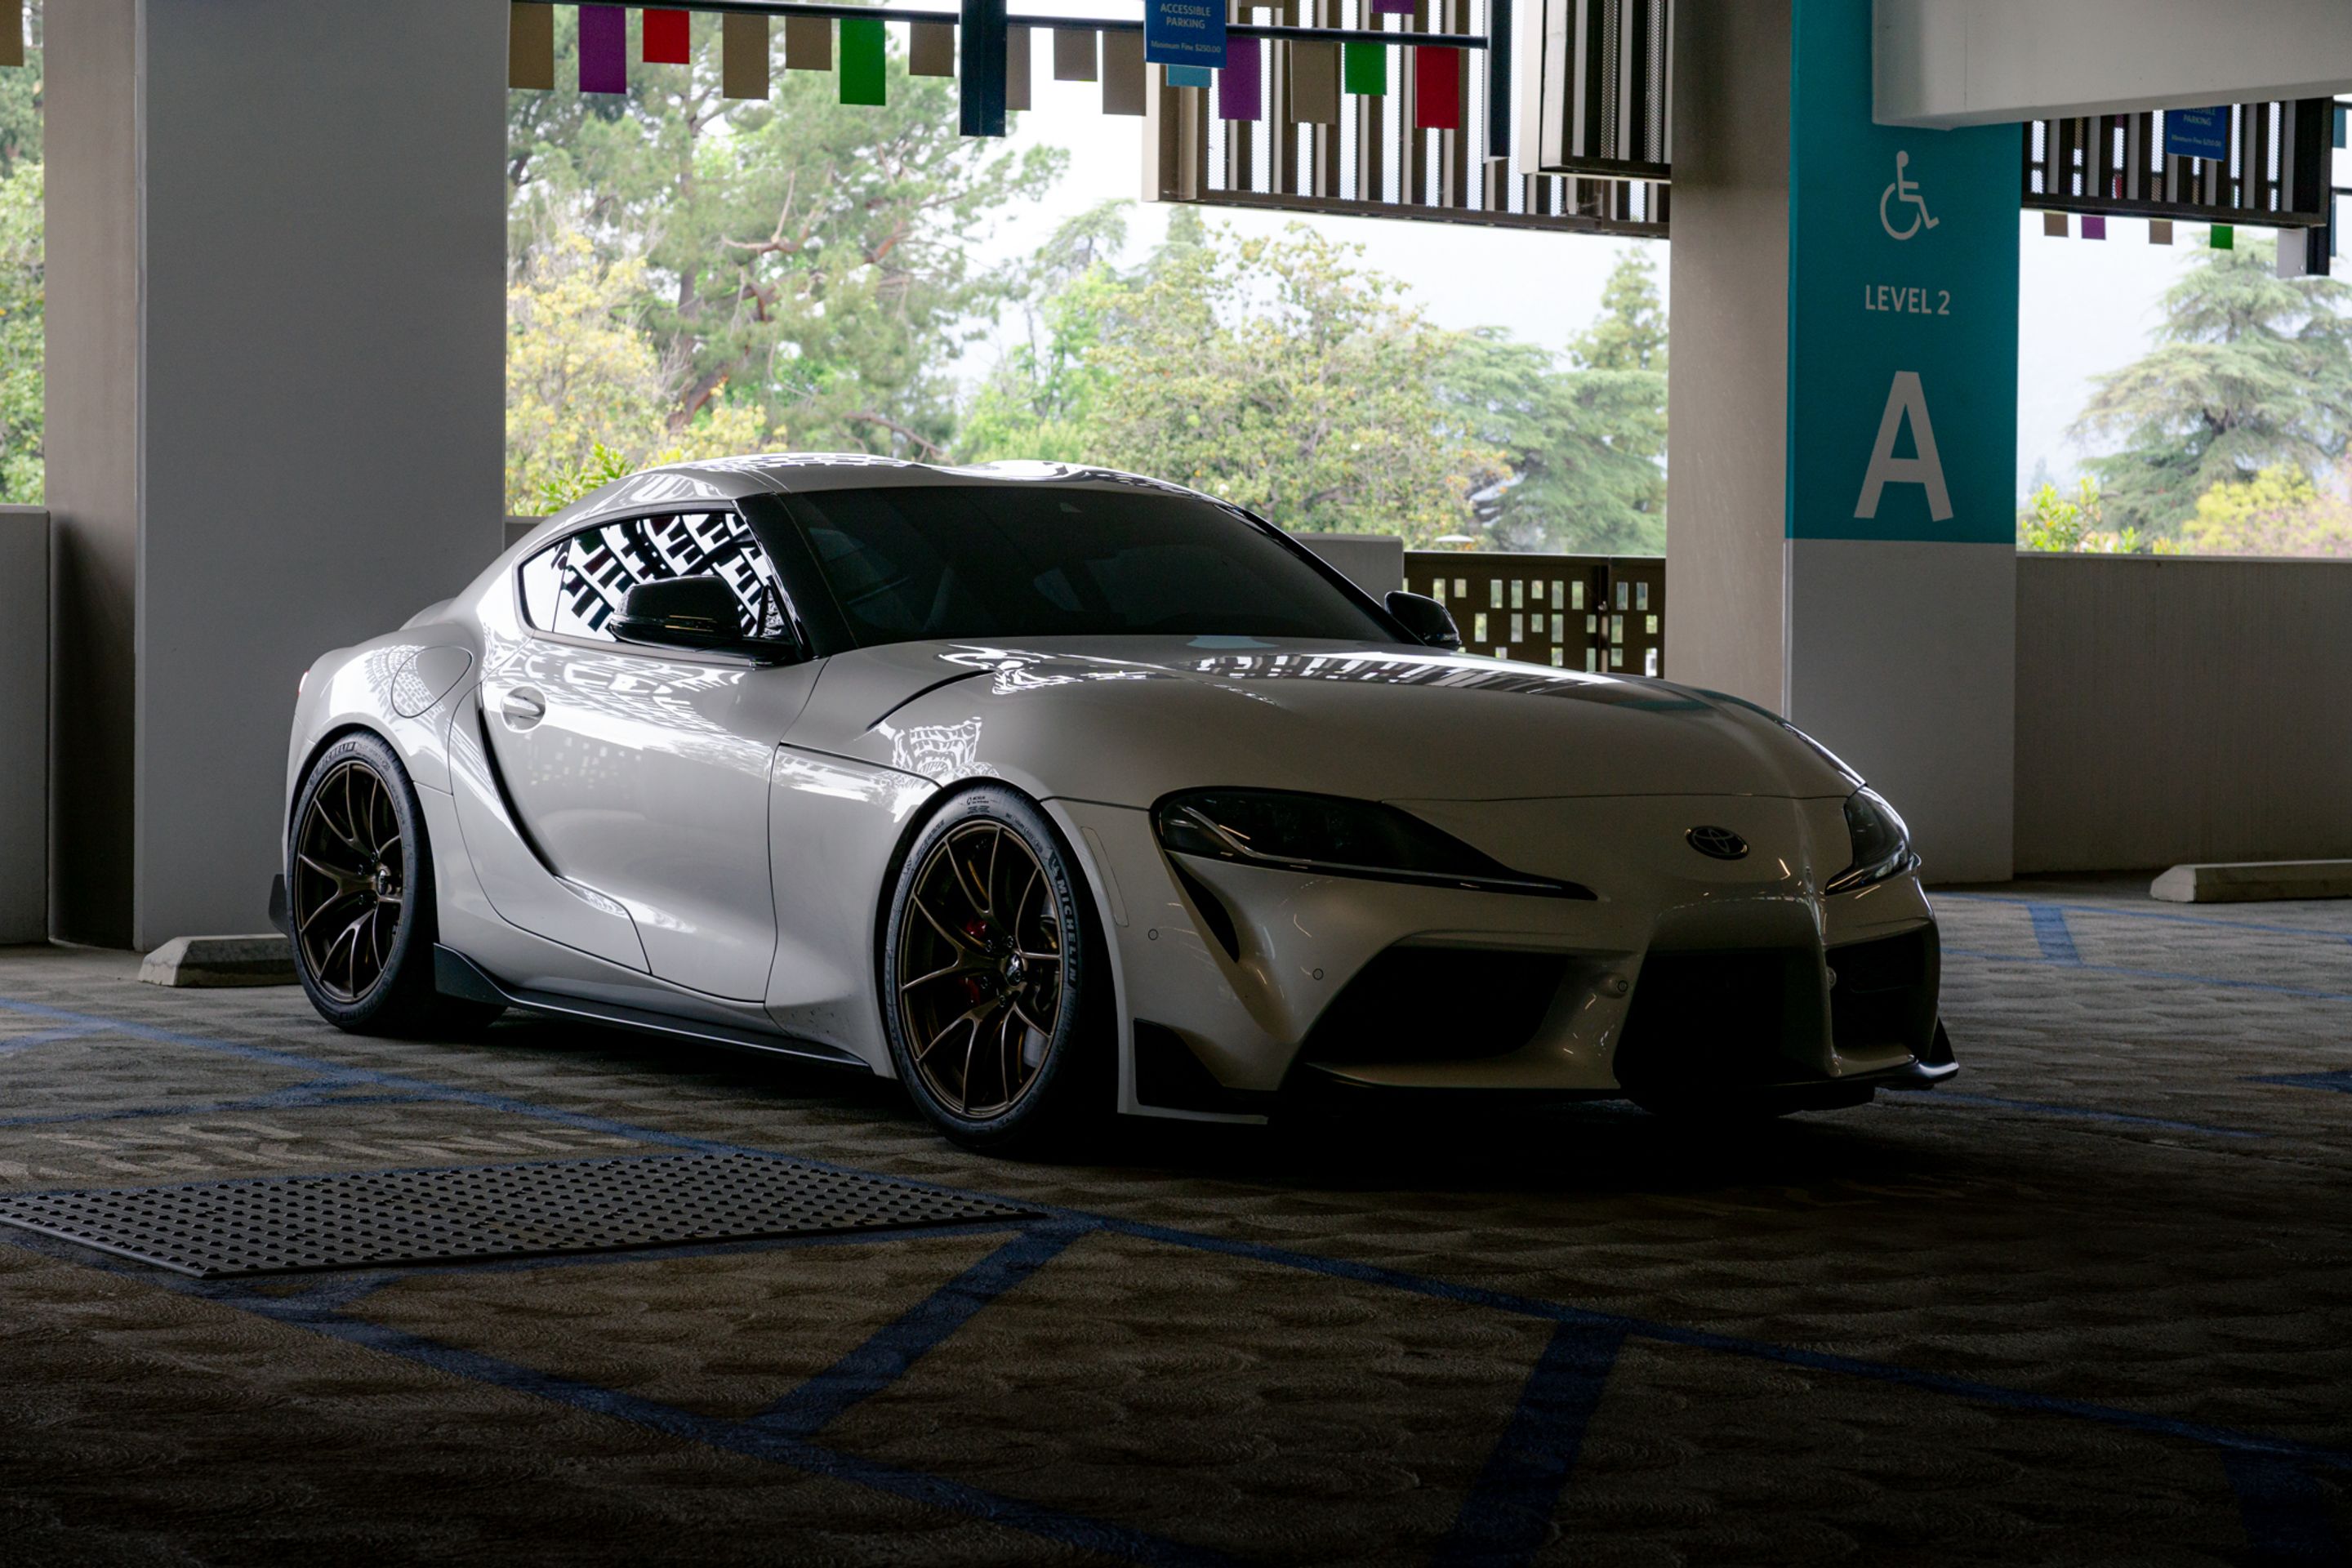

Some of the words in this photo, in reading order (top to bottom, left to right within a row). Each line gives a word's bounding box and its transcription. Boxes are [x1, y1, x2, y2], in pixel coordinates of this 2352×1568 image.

[1160, 3, 1211, 16] ACCESSIBLE
[1166, 16, 1205, 29] PARKING
[1150, 40, 1180, 50] Minimum
[1181, 42, 1193, 51] Fine
[1195, 43, 1222, 53] $250.00
[2183, 114, 2212, 126] PARKING
[1865, 285, 1932, 314] LEVEL
[1937, 290, 1951, 315] 2
[1854, 370, 1954, 523] A
[1056, 879, 1079, 983] MICHELIN
